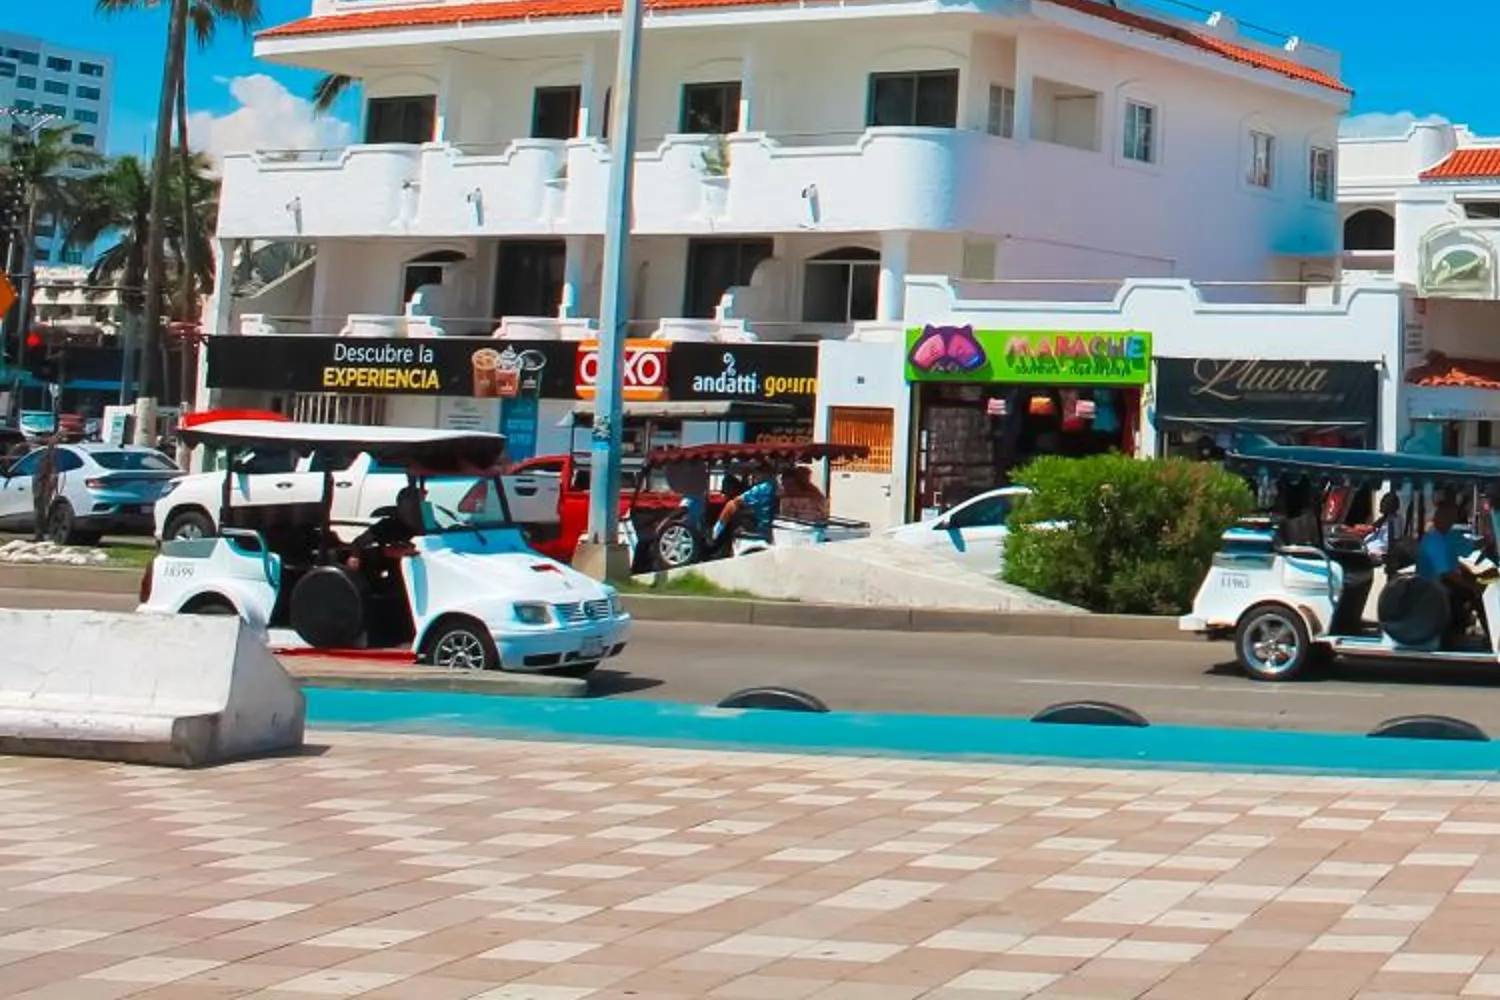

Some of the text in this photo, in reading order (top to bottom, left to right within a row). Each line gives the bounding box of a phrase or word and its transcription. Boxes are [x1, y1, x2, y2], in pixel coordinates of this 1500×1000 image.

[333, 343, 434, 363] Descubre la
[322, 367, 441, 390] EXPERIENCIA
[580, 350, 662, 386] OXO
[692, 371, 758, 395] andatti
